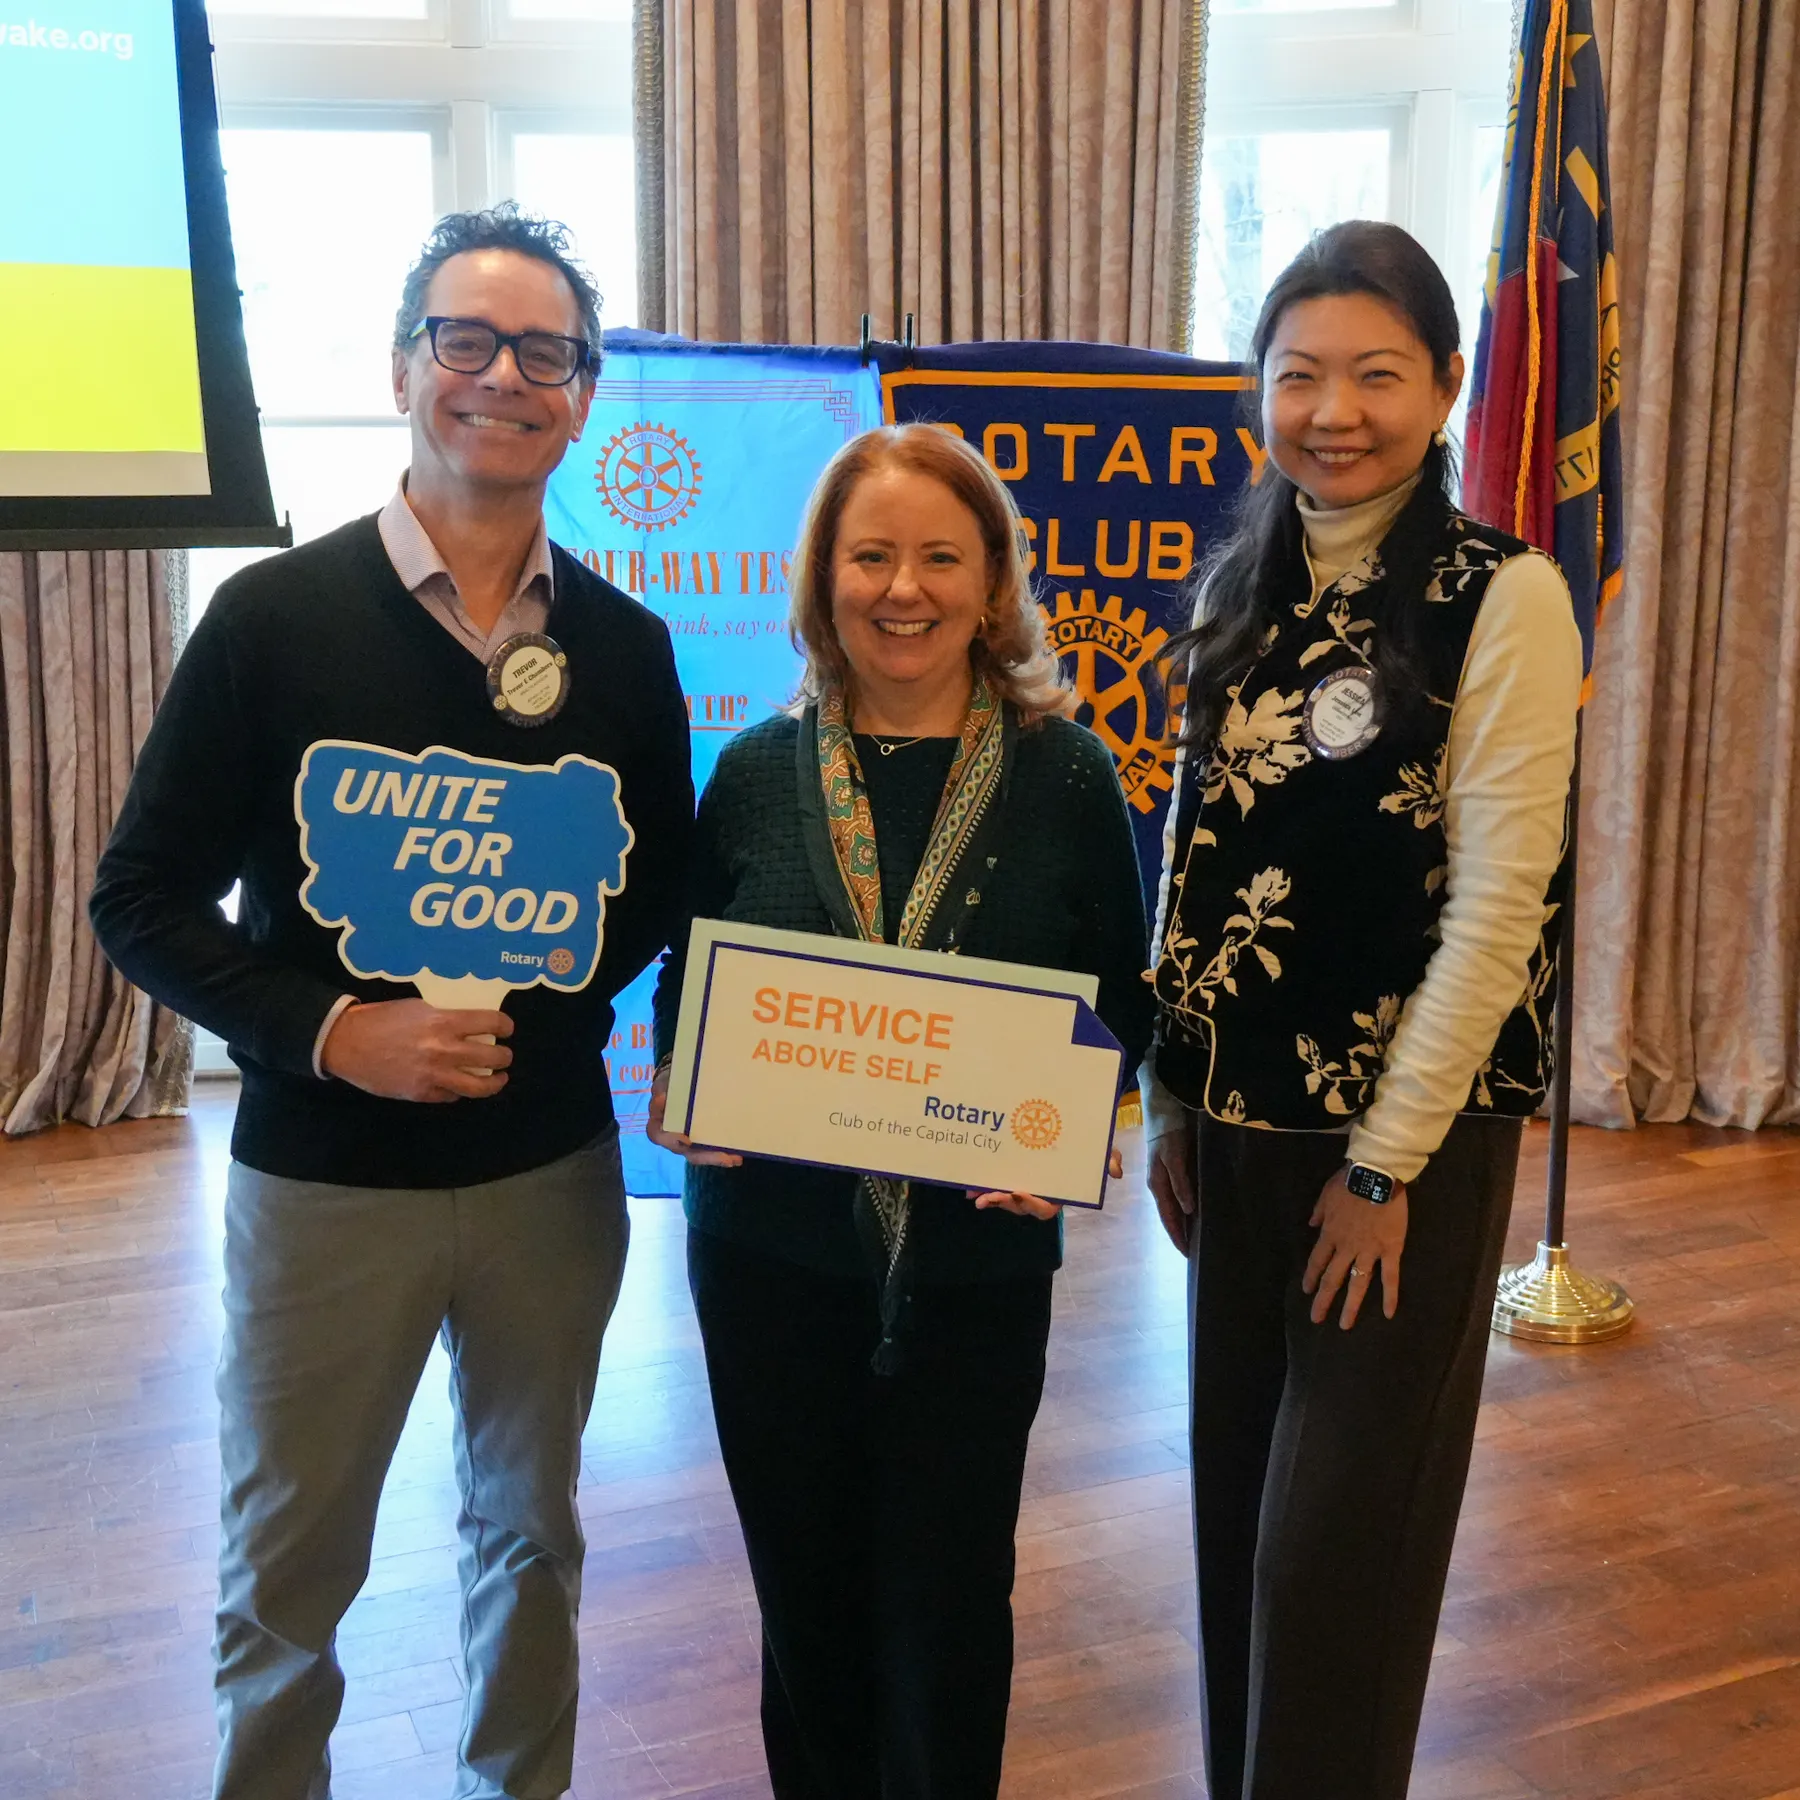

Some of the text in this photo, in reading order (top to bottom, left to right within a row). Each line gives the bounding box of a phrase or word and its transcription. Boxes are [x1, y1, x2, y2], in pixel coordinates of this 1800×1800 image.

[629, 433, 671, 446] ROTARY
[930, 422, 1269, 487] OTARY
[612, 494, 686, 521] INTERNATIONAL
[724, 620, 760, 640] say
[512, 657, 538, 679] TREVOR
[333, 768, 507, 823] UNITE
[393, 827, 513, 877] FOR
[410, 882, 578, 934] GOOD
[501, 951, 544, 968] Rotary
[752, 987, 954, 1050] SERVICE
[752, 1039, 941, 1086] ABOVE SELF
[828, 1111, 1002, 1153] Club of the Capital City
[924, 1096, 1005, 1132] Rotary
